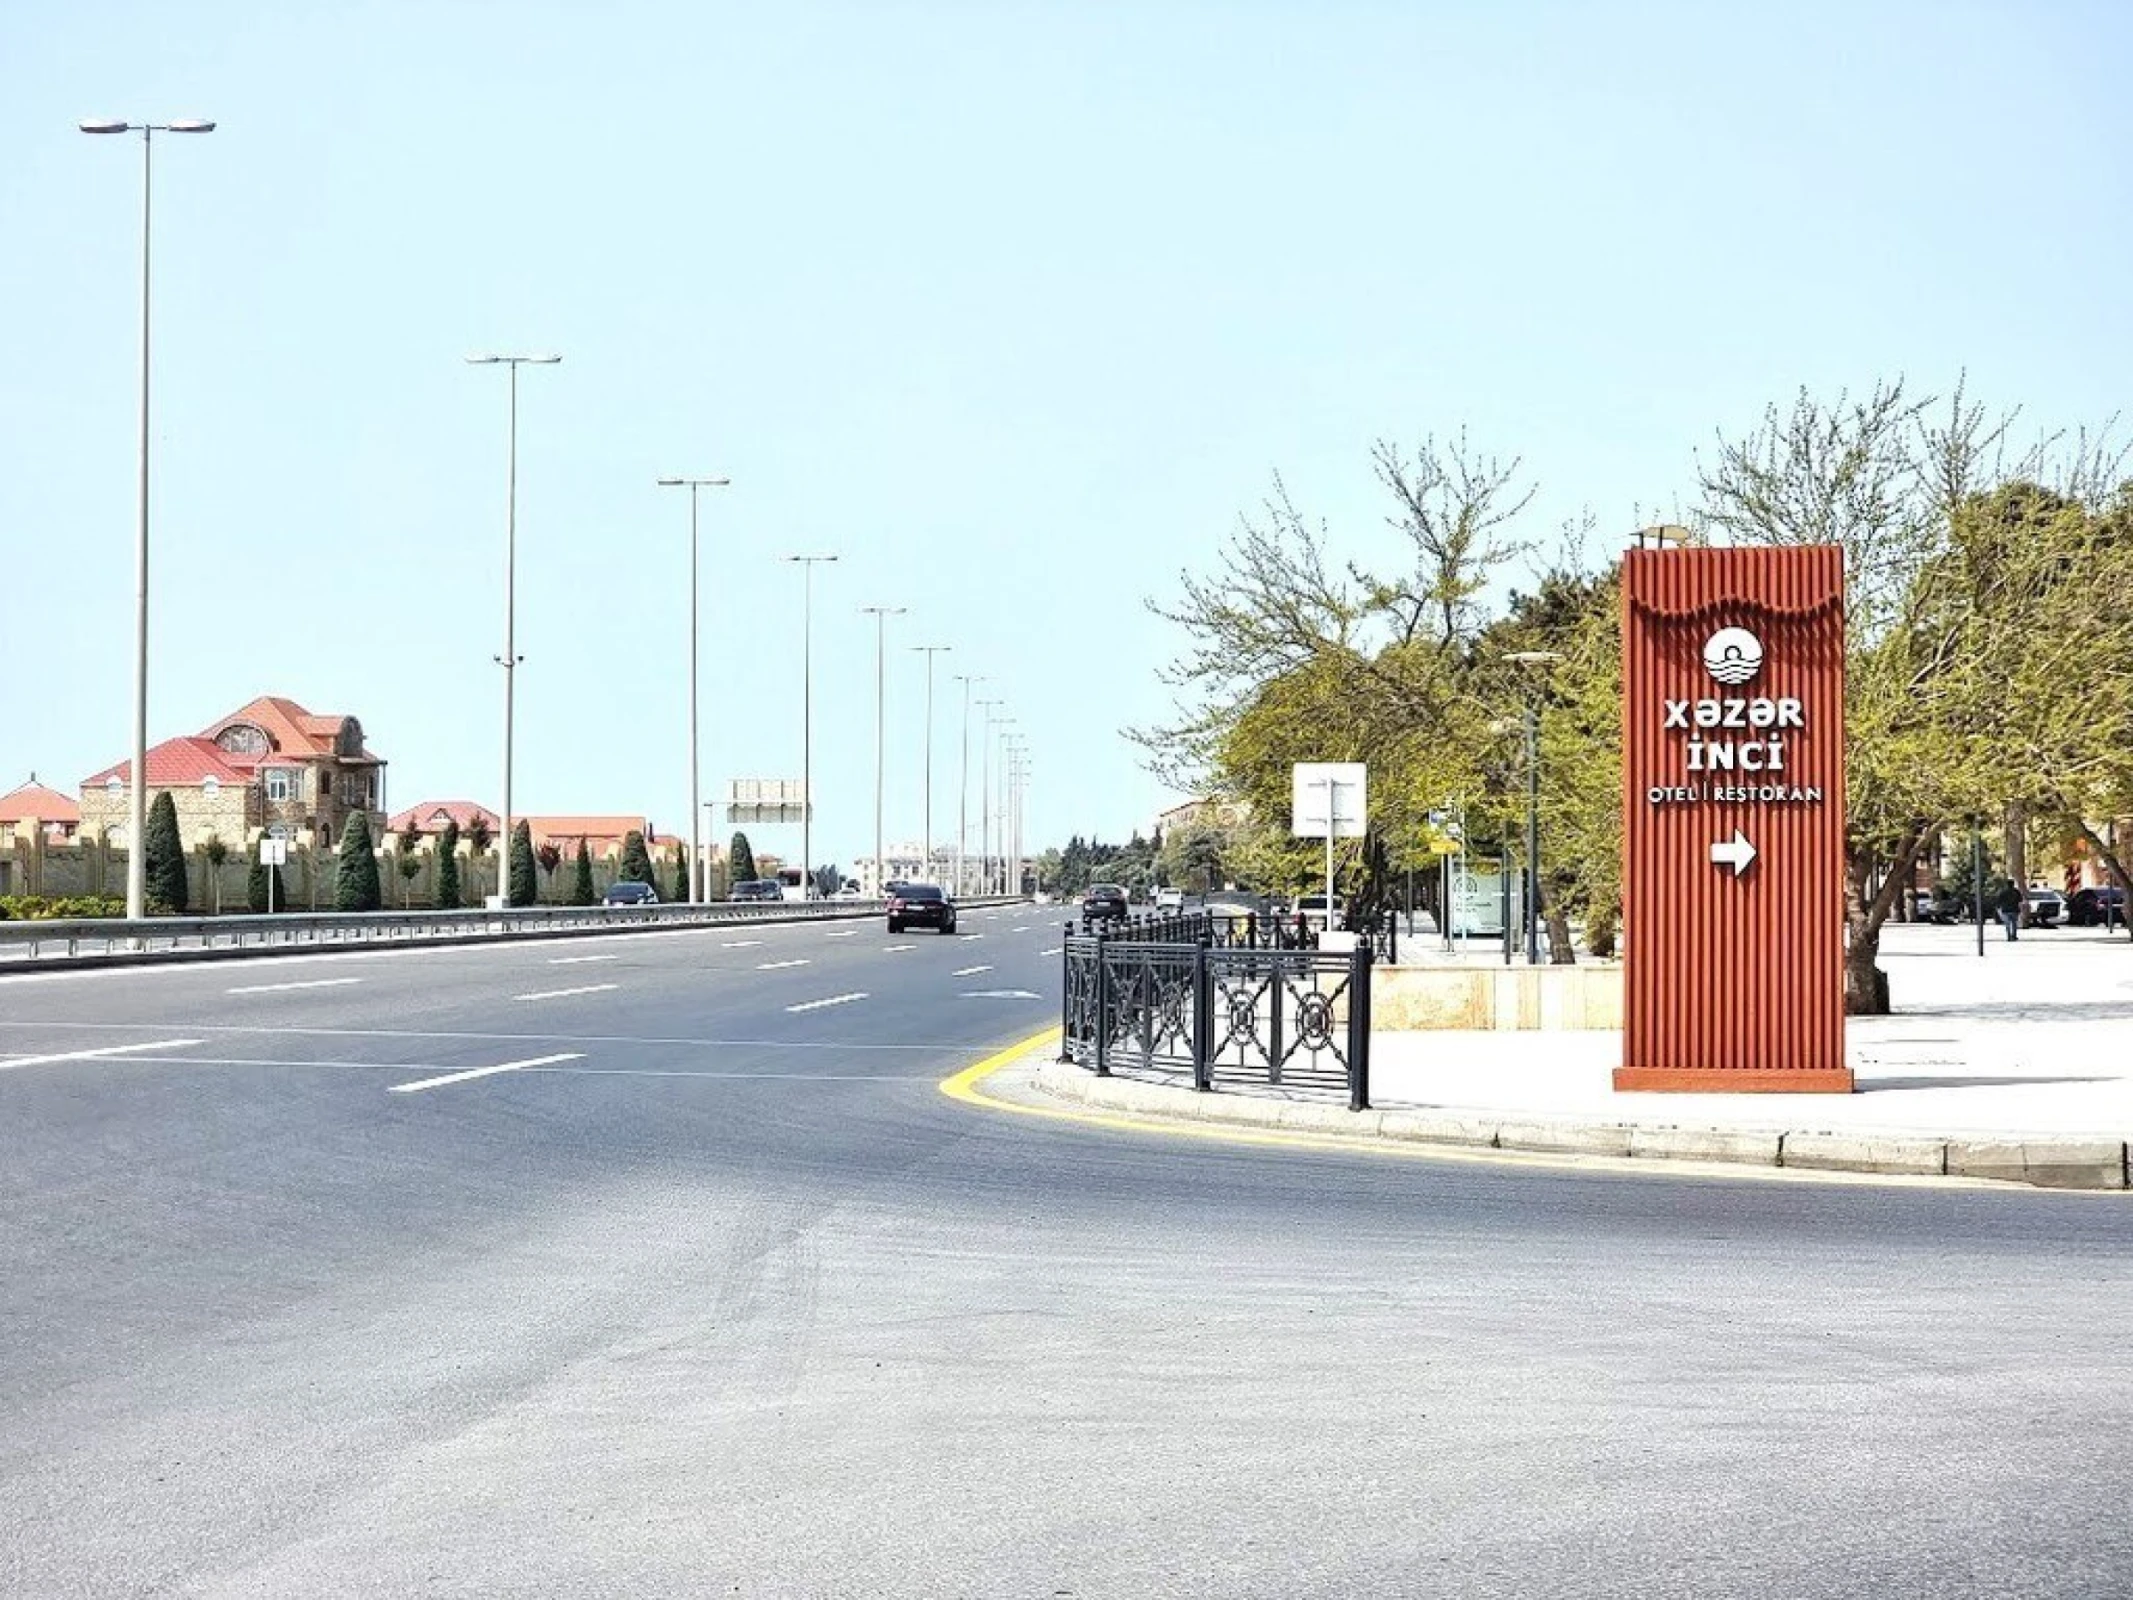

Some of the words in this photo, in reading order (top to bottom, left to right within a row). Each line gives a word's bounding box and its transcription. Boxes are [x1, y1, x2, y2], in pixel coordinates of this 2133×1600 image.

[1664, 699, 1804, 728] XƏZƏR
[1687, 733, 1783, 770] İNCİ
[1647, 786, 1697, 803] OTEL
[1713, 786, 1821, 802] RESTORAN
